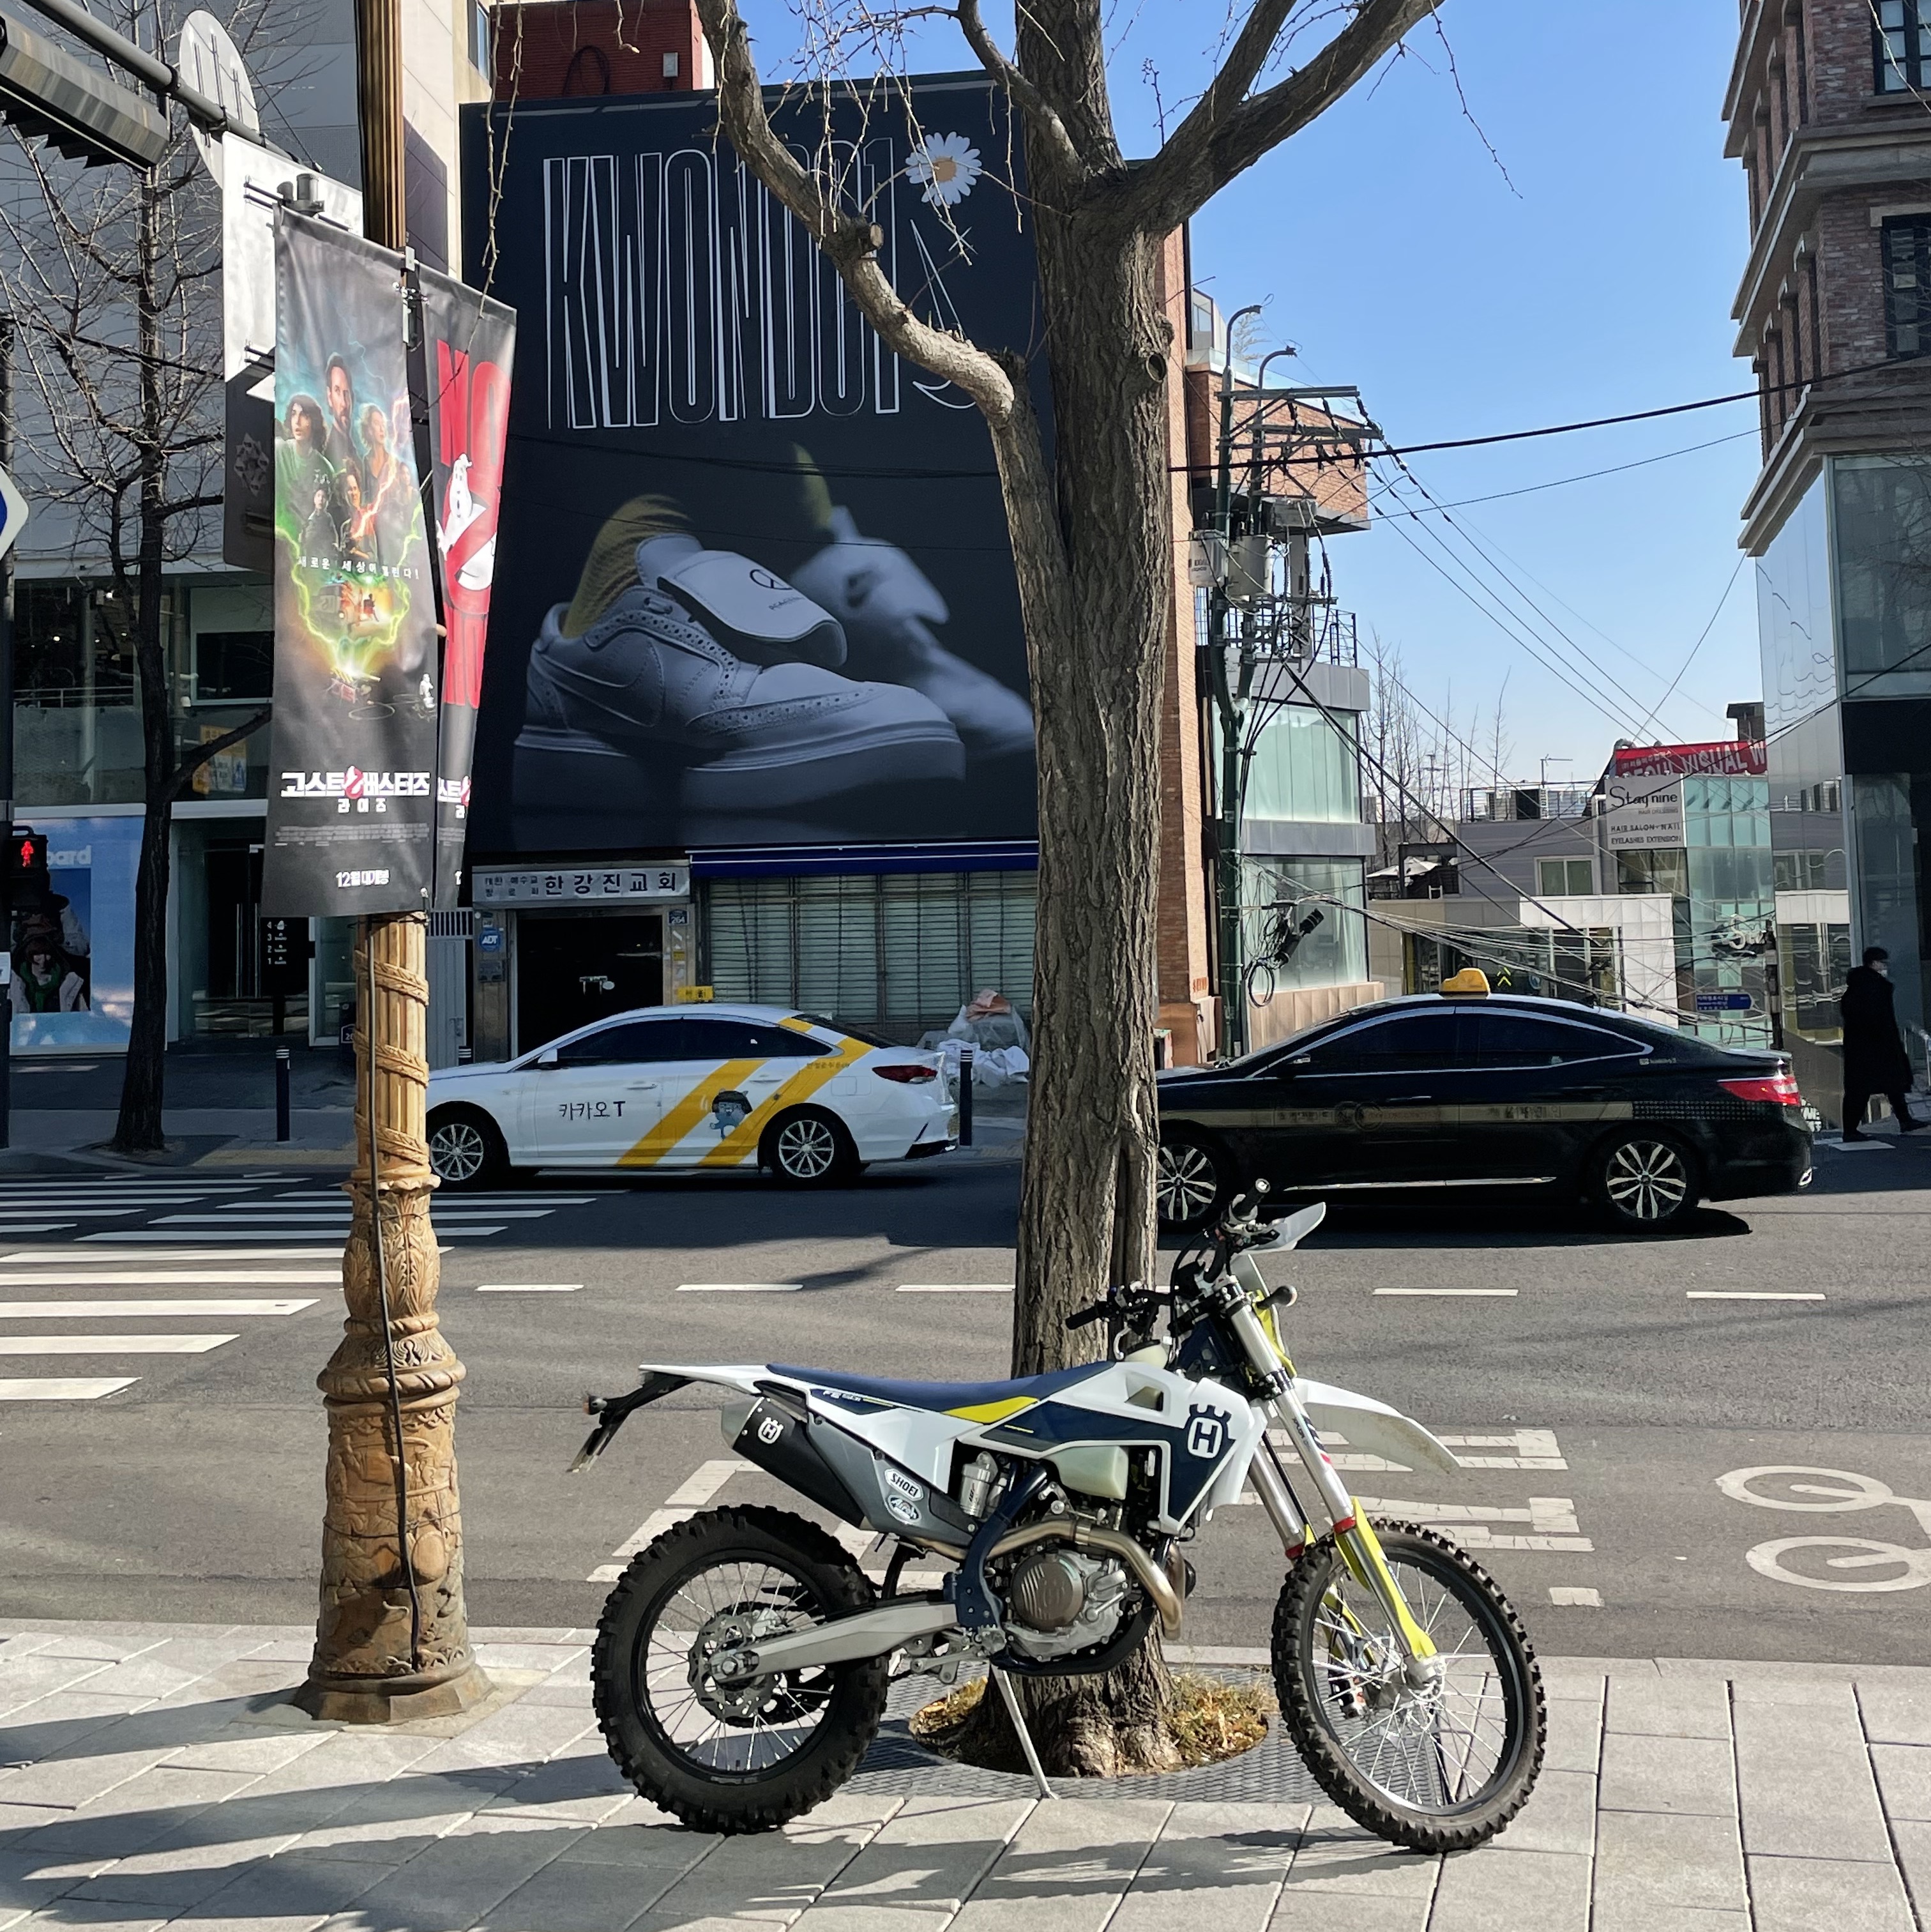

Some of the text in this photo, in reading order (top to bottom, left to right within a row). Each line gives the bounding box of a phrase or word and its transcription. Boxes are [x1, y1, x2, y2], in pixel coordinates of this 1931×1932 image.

[342, 559, 377, 575] 세상이
[280, 772, 431, 797] 고스트버스터즈
[338, 798, 387, 814] 라이즈
[1651, 793, 1678, 805] nine
[1630, 823, 1655, 832] SALON
[545, 871, 677, 895] 한강진교회
[267, 933, 272, 941] 3
[481, 935, 498, 944] ADT
[891, 1473, 918, 1497] SHOEI
